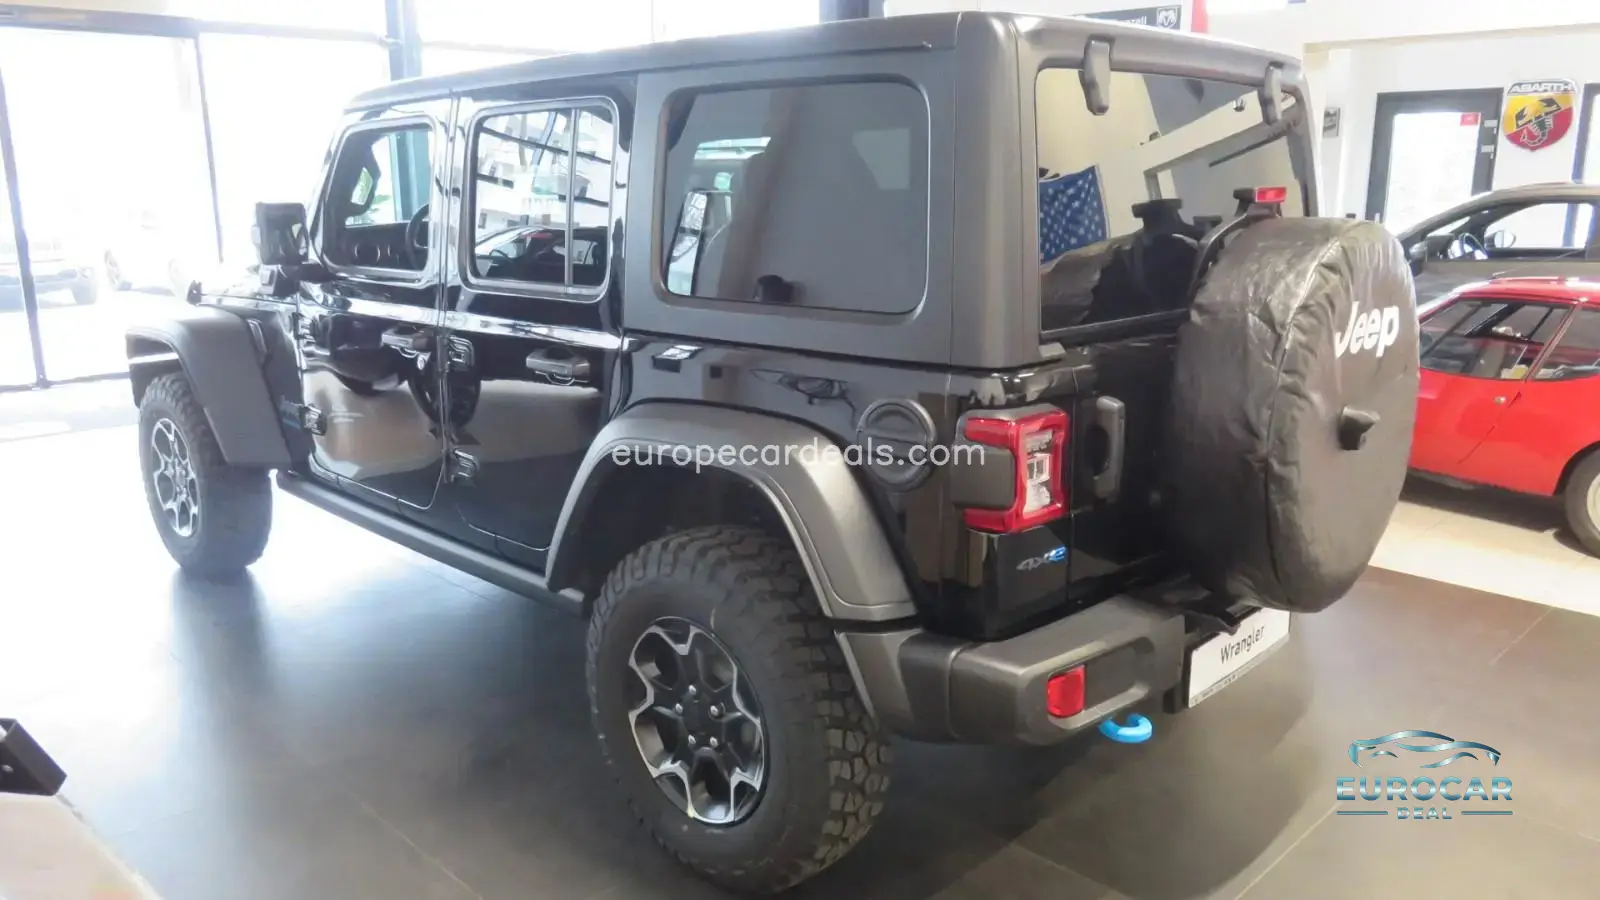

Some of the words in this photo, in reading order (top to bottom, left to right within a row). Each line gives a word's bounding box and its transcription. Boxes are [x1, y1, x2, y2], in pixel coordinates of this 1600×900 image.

[1509, 82, 1575, 93] ABARTH
[1335, 301, 1400, 359] Jeep
[1220, 626, 1265, 664] Wrangler
